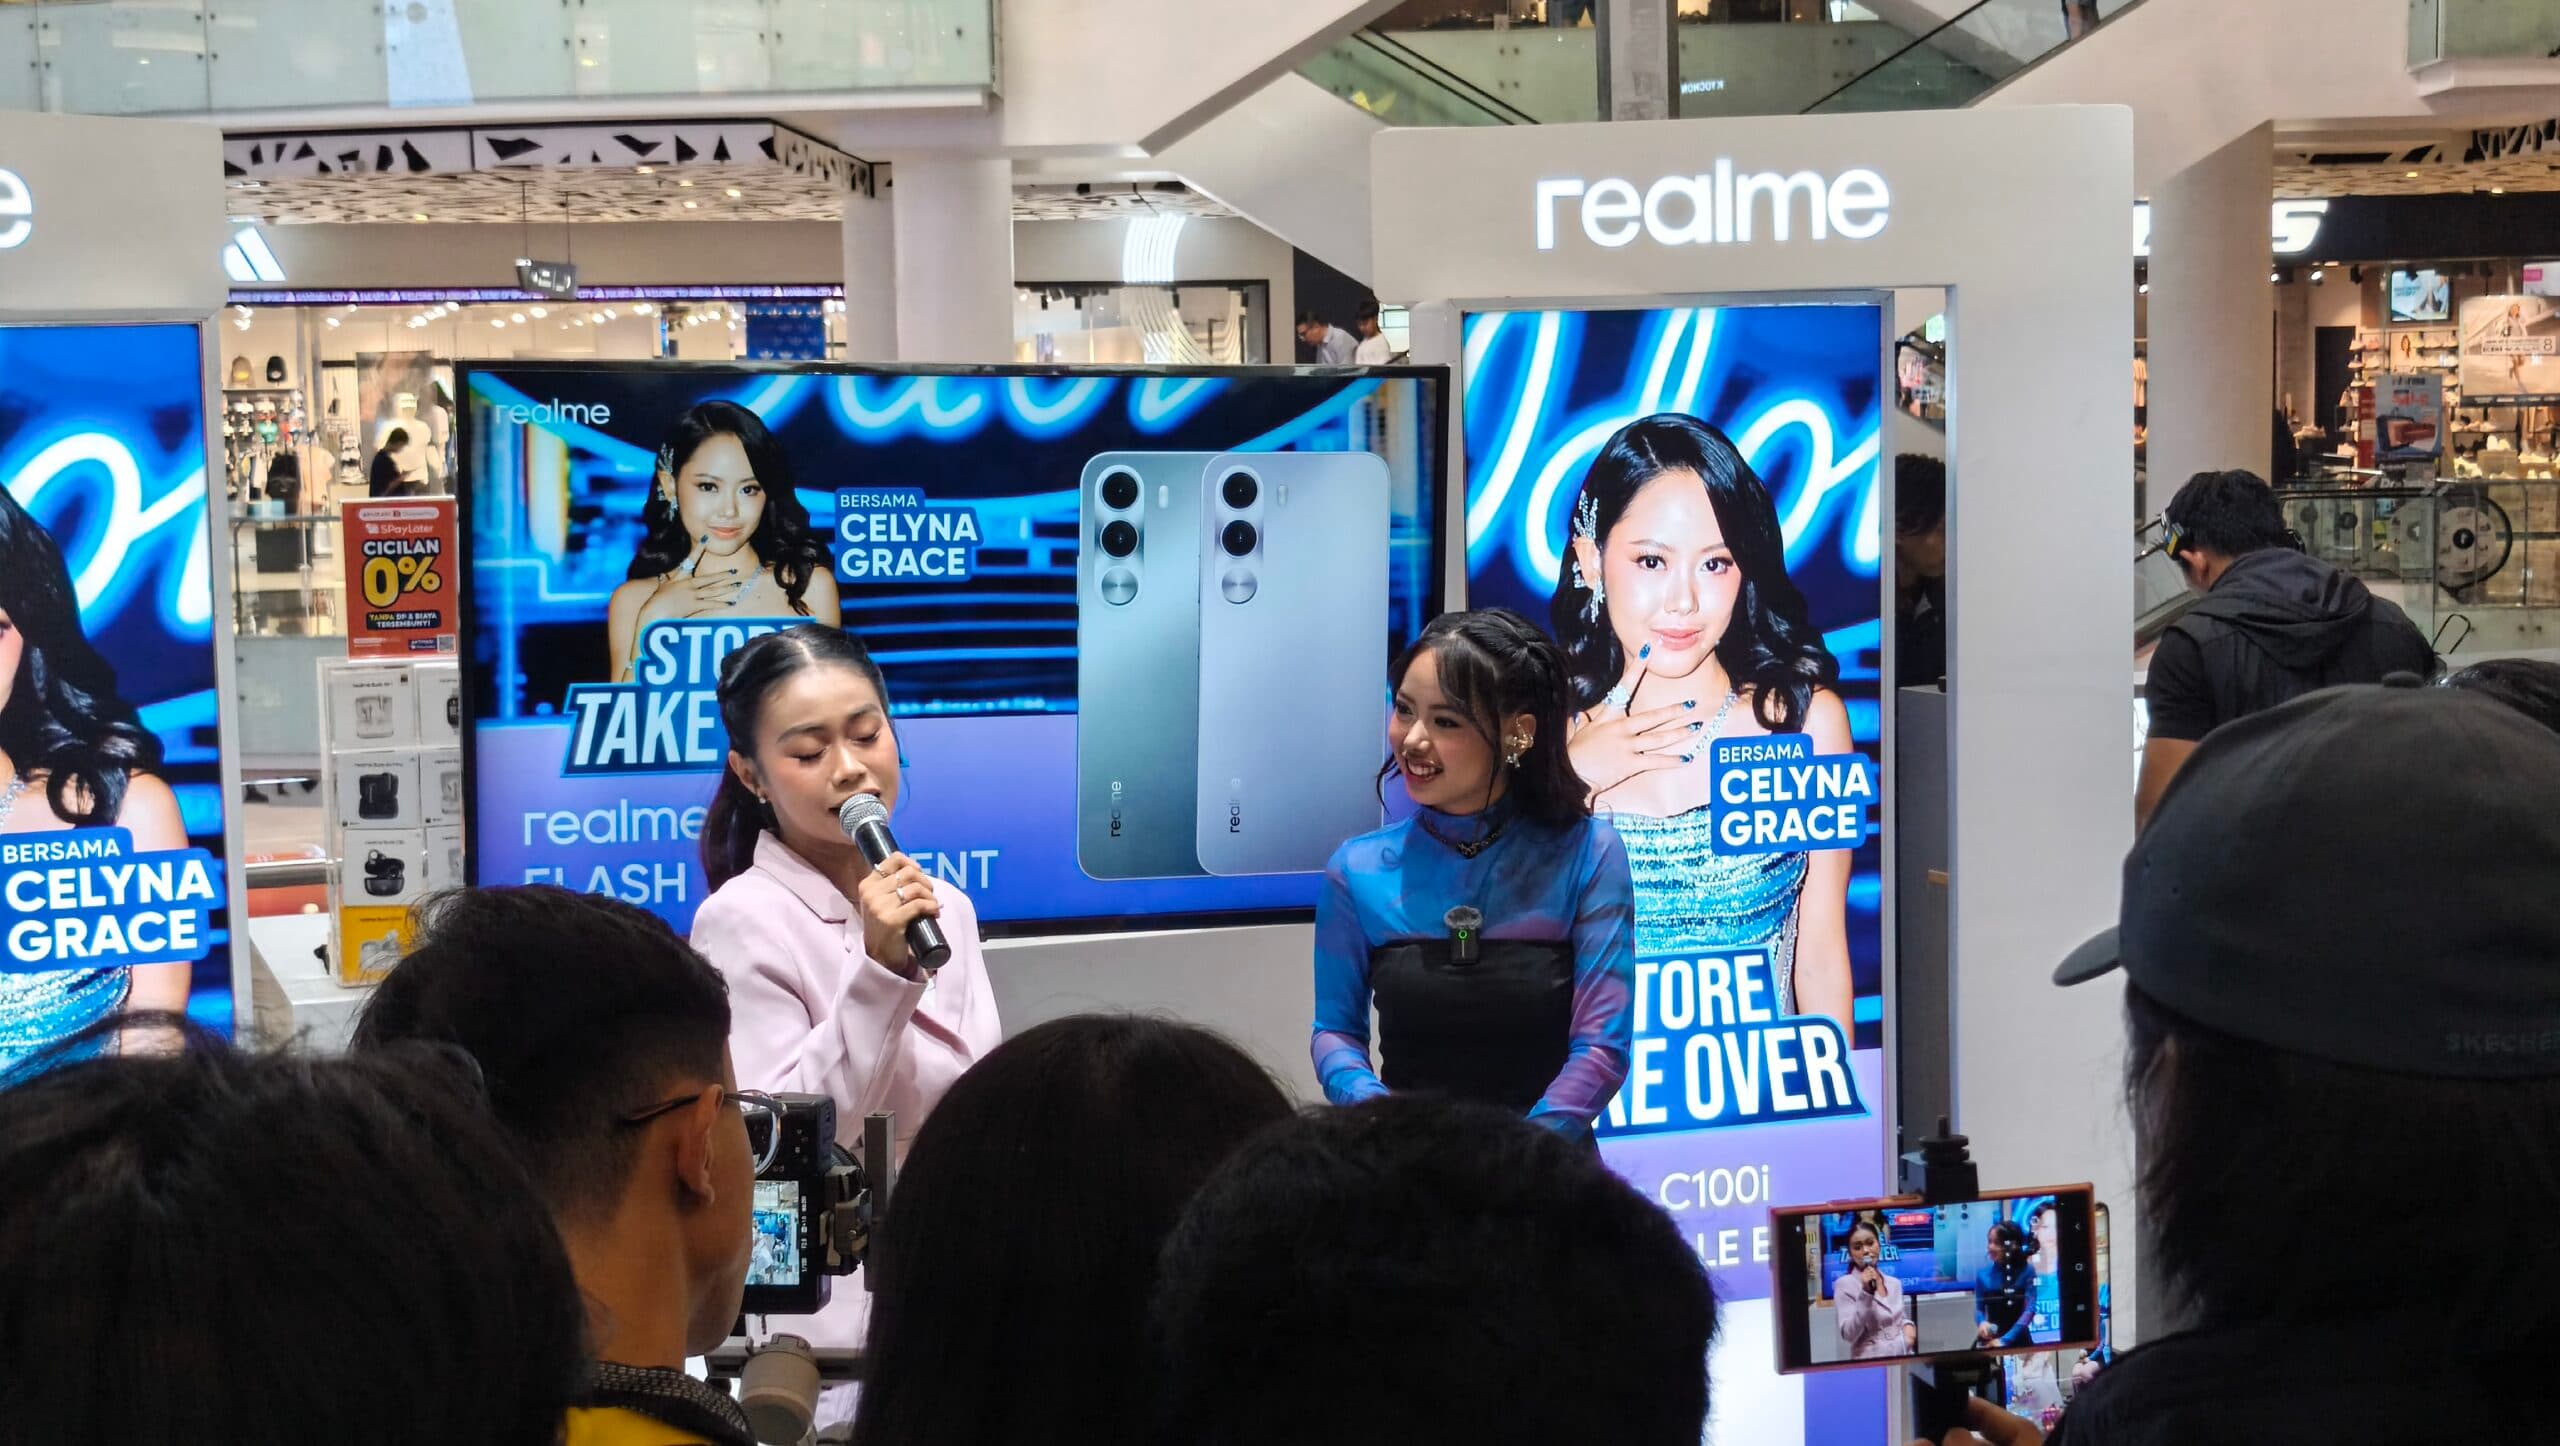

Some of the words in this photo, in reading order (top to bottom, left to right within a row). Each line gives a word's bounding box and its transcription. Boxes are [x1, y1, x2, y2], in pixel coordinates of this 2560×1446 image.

[1537, 158, 1891, 250] realme
[495, 398, 611, 425] realme
[840, 494, 918, 508] BERSAMA
[363, 540, 440, 555] CICILAN
[380, 524, 434, 536] SPayLater
[840, 513, 978, 543] CELYNA
[364, 556, 441, 607] 0%
[840, 547, 966, 577] GRACE
[645, 625, 797, 686] STO
[574, 689, 719, 766] TAKE
[1719, 743, 1804, 763] BERSAMA
[1719, 763, 1872, 804] CELYNA
[524, 799, 707, 846] realme
[1719, 804, 1858, 847] GRACE
[2, 838, 121, 864] BERSAMA
[5, 859, 215, 912] CELYNA
[8, 909, 198, 962] GRACE
[1633, 954, 1772, 1033] TORE
[1684, 1025, 1852, 1121] OVER
[1659, 1164, 1769, 1211] C100i
[1696, 1229, 1740, 1267] LE
[1752, 1226, 1770, 1262] E
